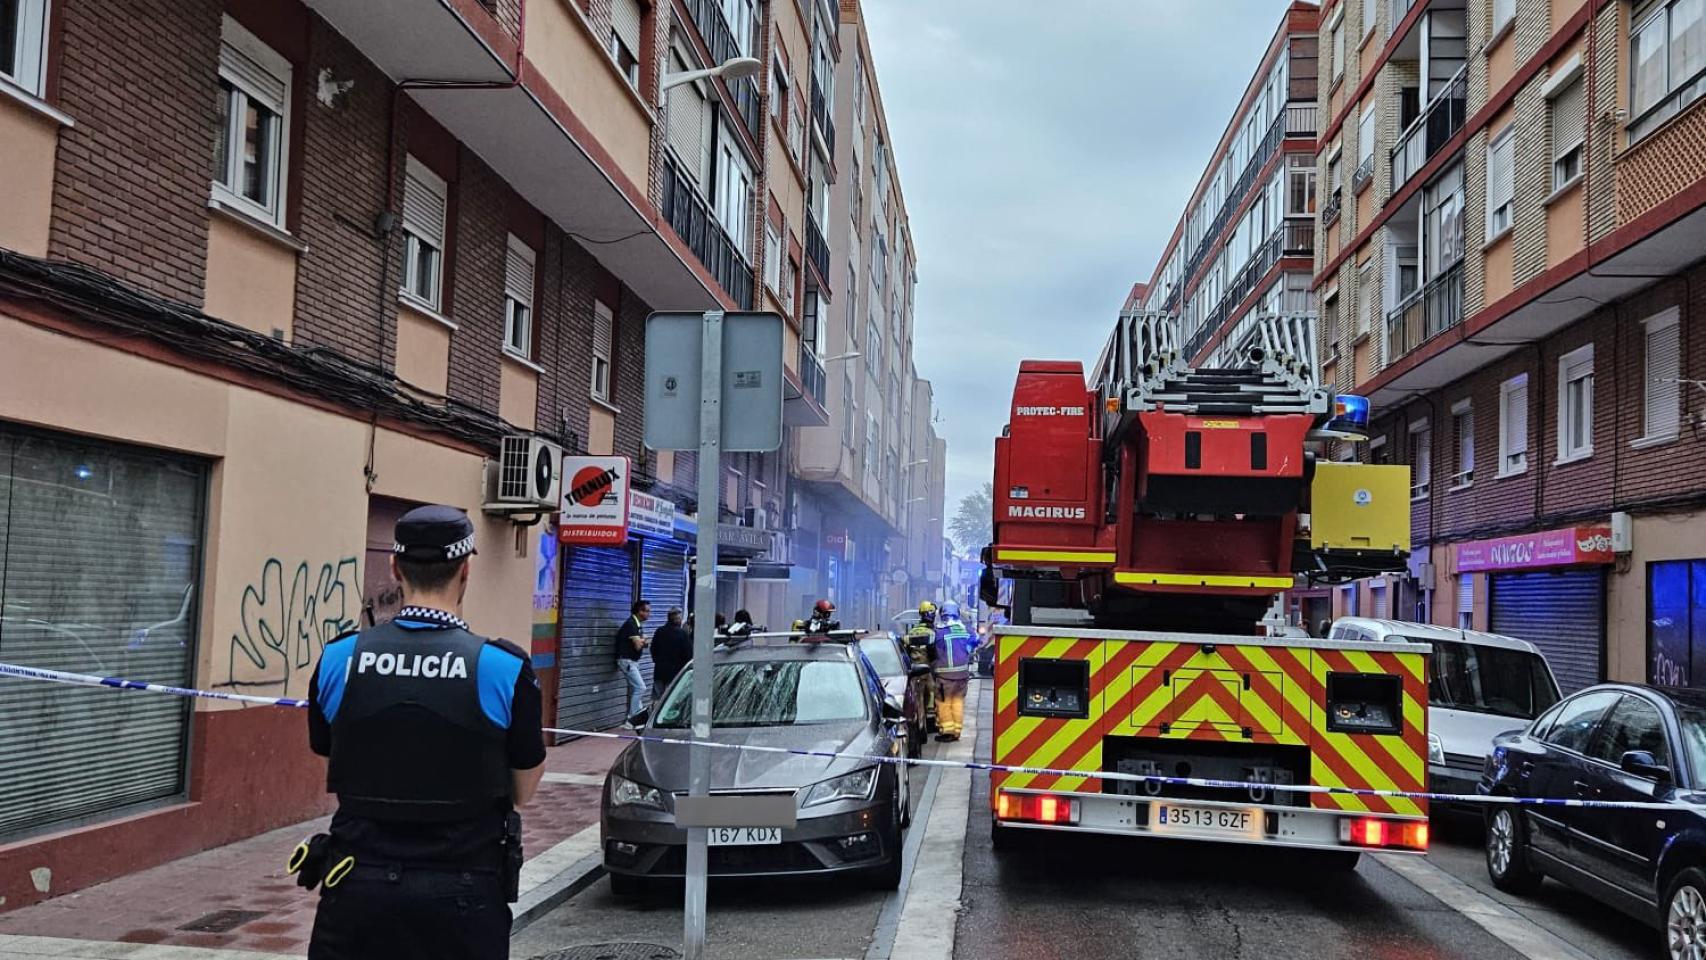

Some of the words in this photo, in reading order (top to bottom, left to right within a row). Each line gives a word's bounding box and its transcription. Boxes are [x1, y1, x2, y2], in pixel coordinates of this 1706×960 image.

[1017, 406, 1084, 416] PROTEC-FIRE
[564, 466, 620, 506] TITANLUX
[1008, 505, 1085, 519] MAGIRUS
[562, 529, 618, 538] DISTRIBUIDOR
[358, 651, 467, 679] POLICÍA
[1171, 808, 1213, 826] 3513
[1218, 812, 1250, 828] GZF
[746, 827, 778, 842] KDX
